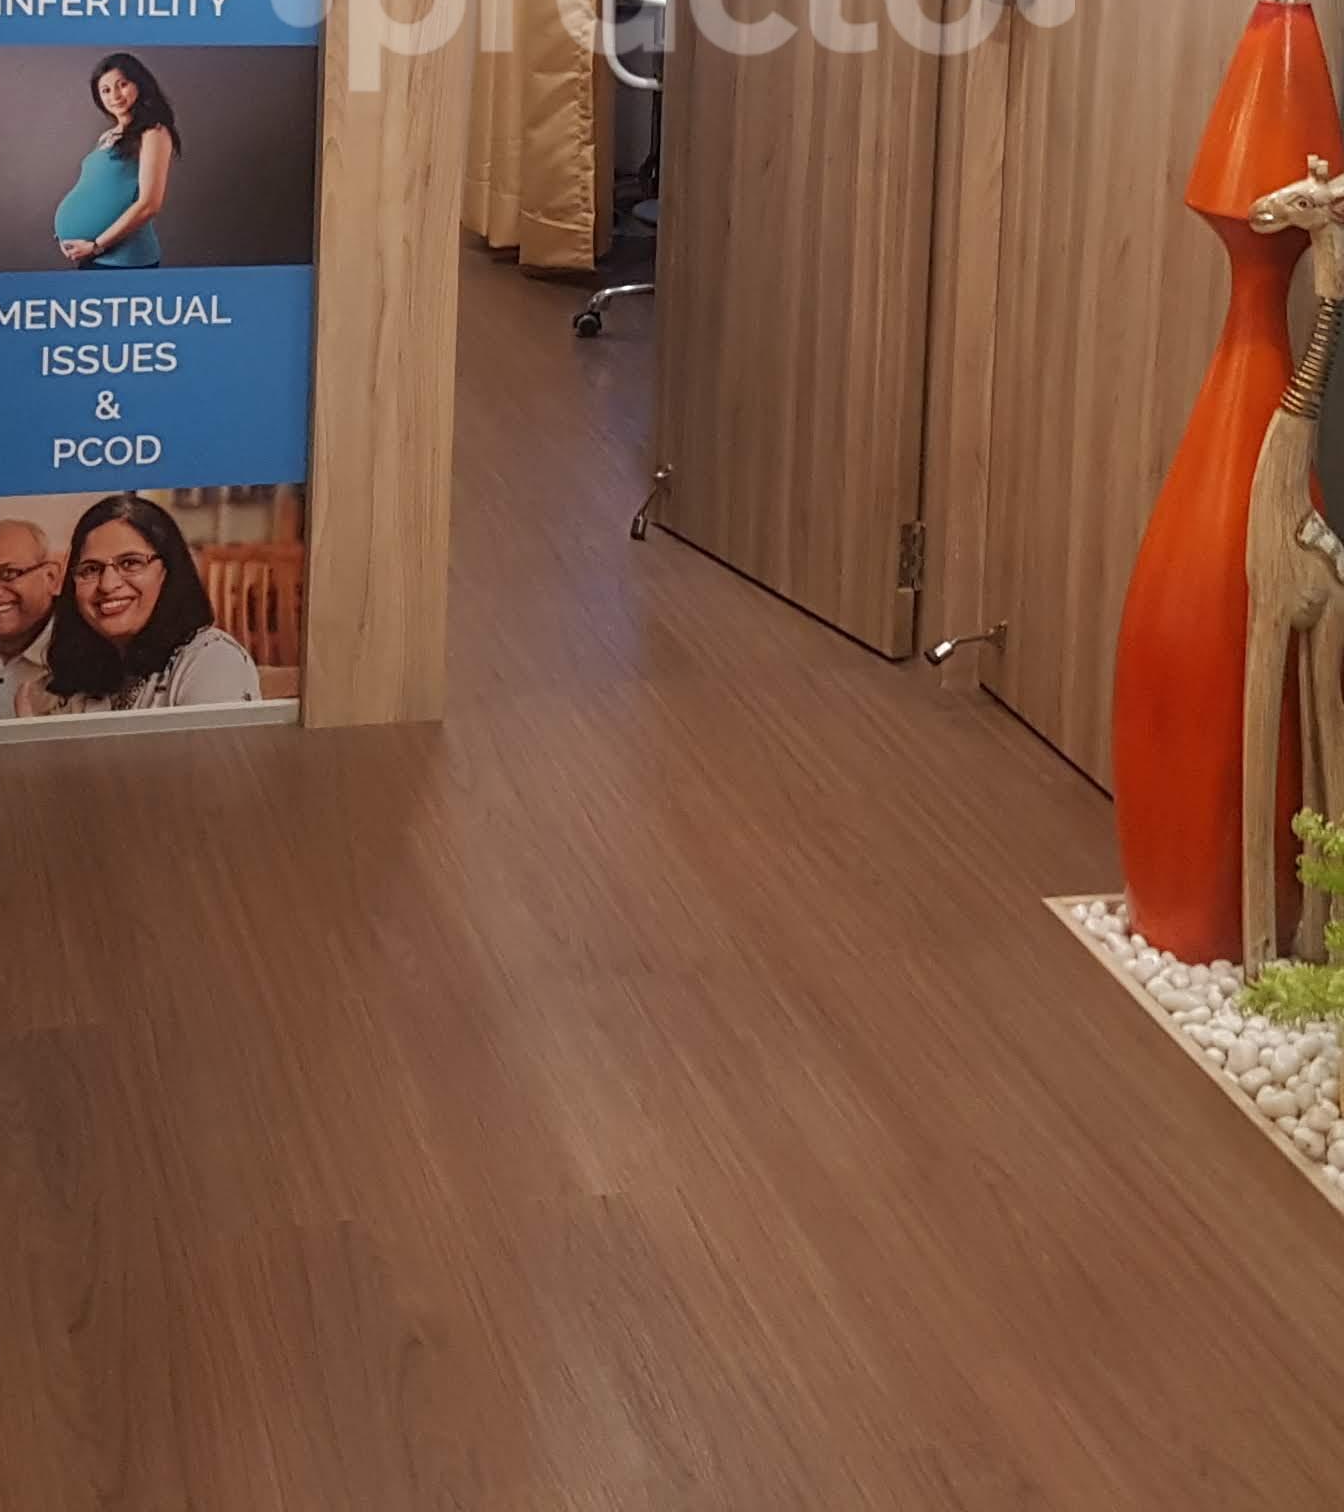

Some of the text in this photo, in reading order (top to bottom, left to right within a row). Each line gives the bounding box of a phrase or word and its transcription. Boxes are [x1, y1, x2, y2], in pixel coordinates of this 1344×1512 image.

[40, 342, 178, 376] ISSUES
[94, 390, 122, 422] &
[52, 435, 162, 469] PCOD
